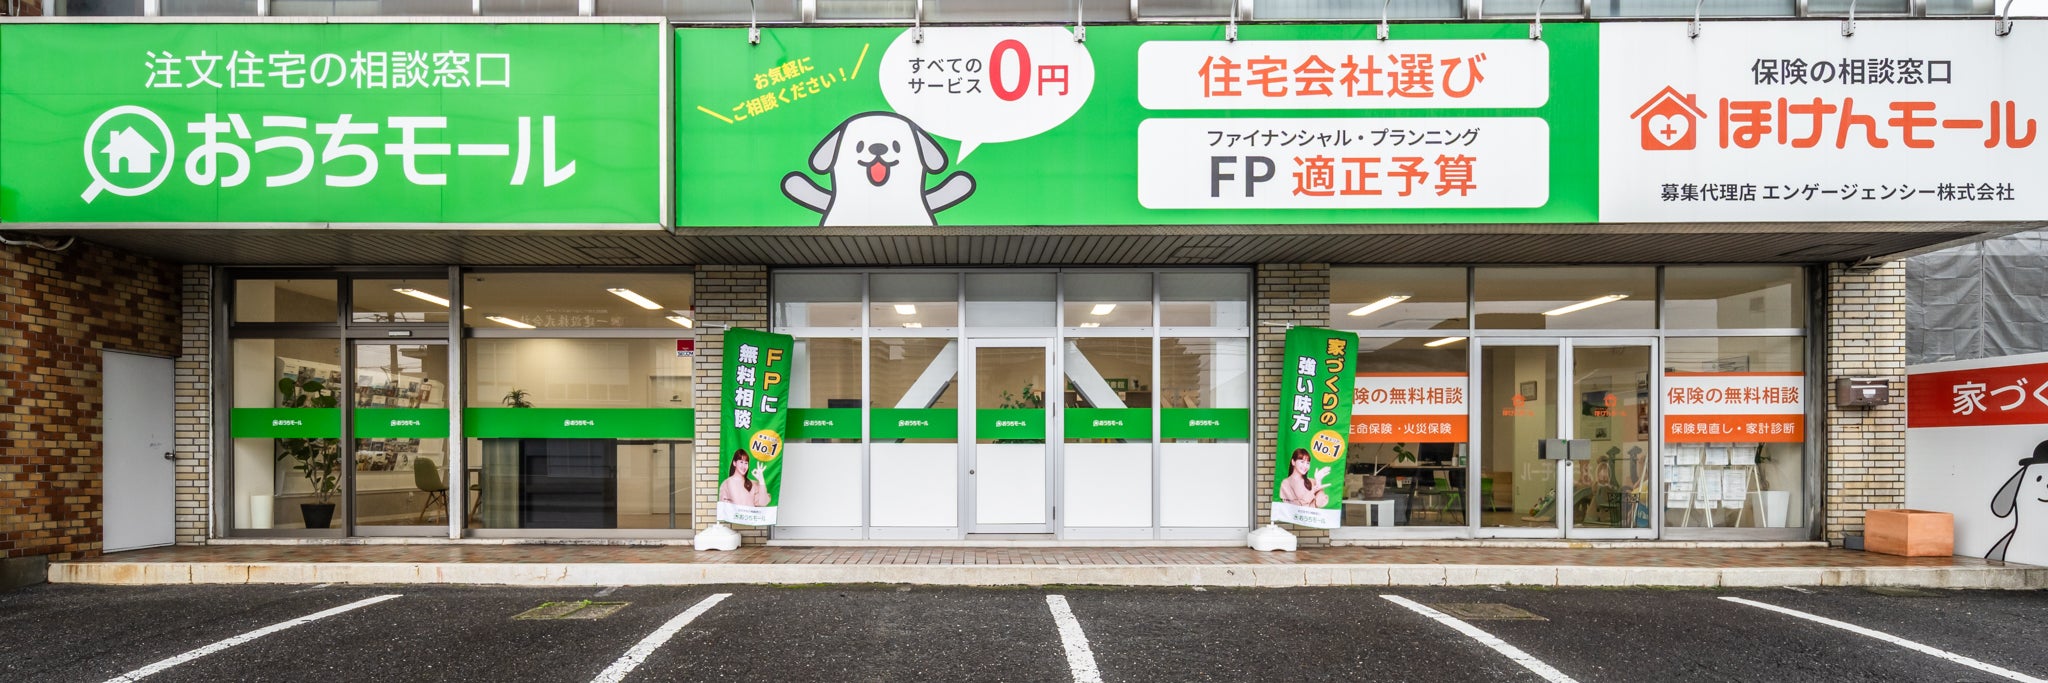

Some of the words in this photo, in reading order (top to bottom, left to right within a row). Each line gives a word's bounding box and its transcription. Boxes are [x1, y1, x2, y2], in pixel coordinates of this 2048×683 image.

[144, 49, 511, 89] 注文住宅の相談窓口
[753, 56, 815, 91] お気軽に
[908, 57, 982, 74] すべての
[908, 77, 982, 94] サービス
[989, 39, 1070, 102] 0円
[1198, 52, 1488, 98] 住宅会社選び
[1751, 57, 1952, 85] 保険の相談窓口
[1207, 127, 1481, 148] ファイナンシャル・プランニング
[1719, 97, 2037, 149] ほけんモール
[184, 113, 577, 188] おうちモール
[1210, 155, 1276, 198] FP
[1292, 154, 1477, 198] 適正予算
[1660, 182, 1757, 202] 募集代理店
[1762, 182, 2015, 202] エンゲージェンシー株式会社
[734, 343, 759, 430] 無料相談
[761, 348, 784, 413] FPに
[1291, 355, 1318, 433] 強い味方
[1320, 338, 1347, 426] 家づくりの
[1667, 386, 1799, 405] 保険の無料相談
[1671, 422, 1796, 435] 保険見直し・家計診断
